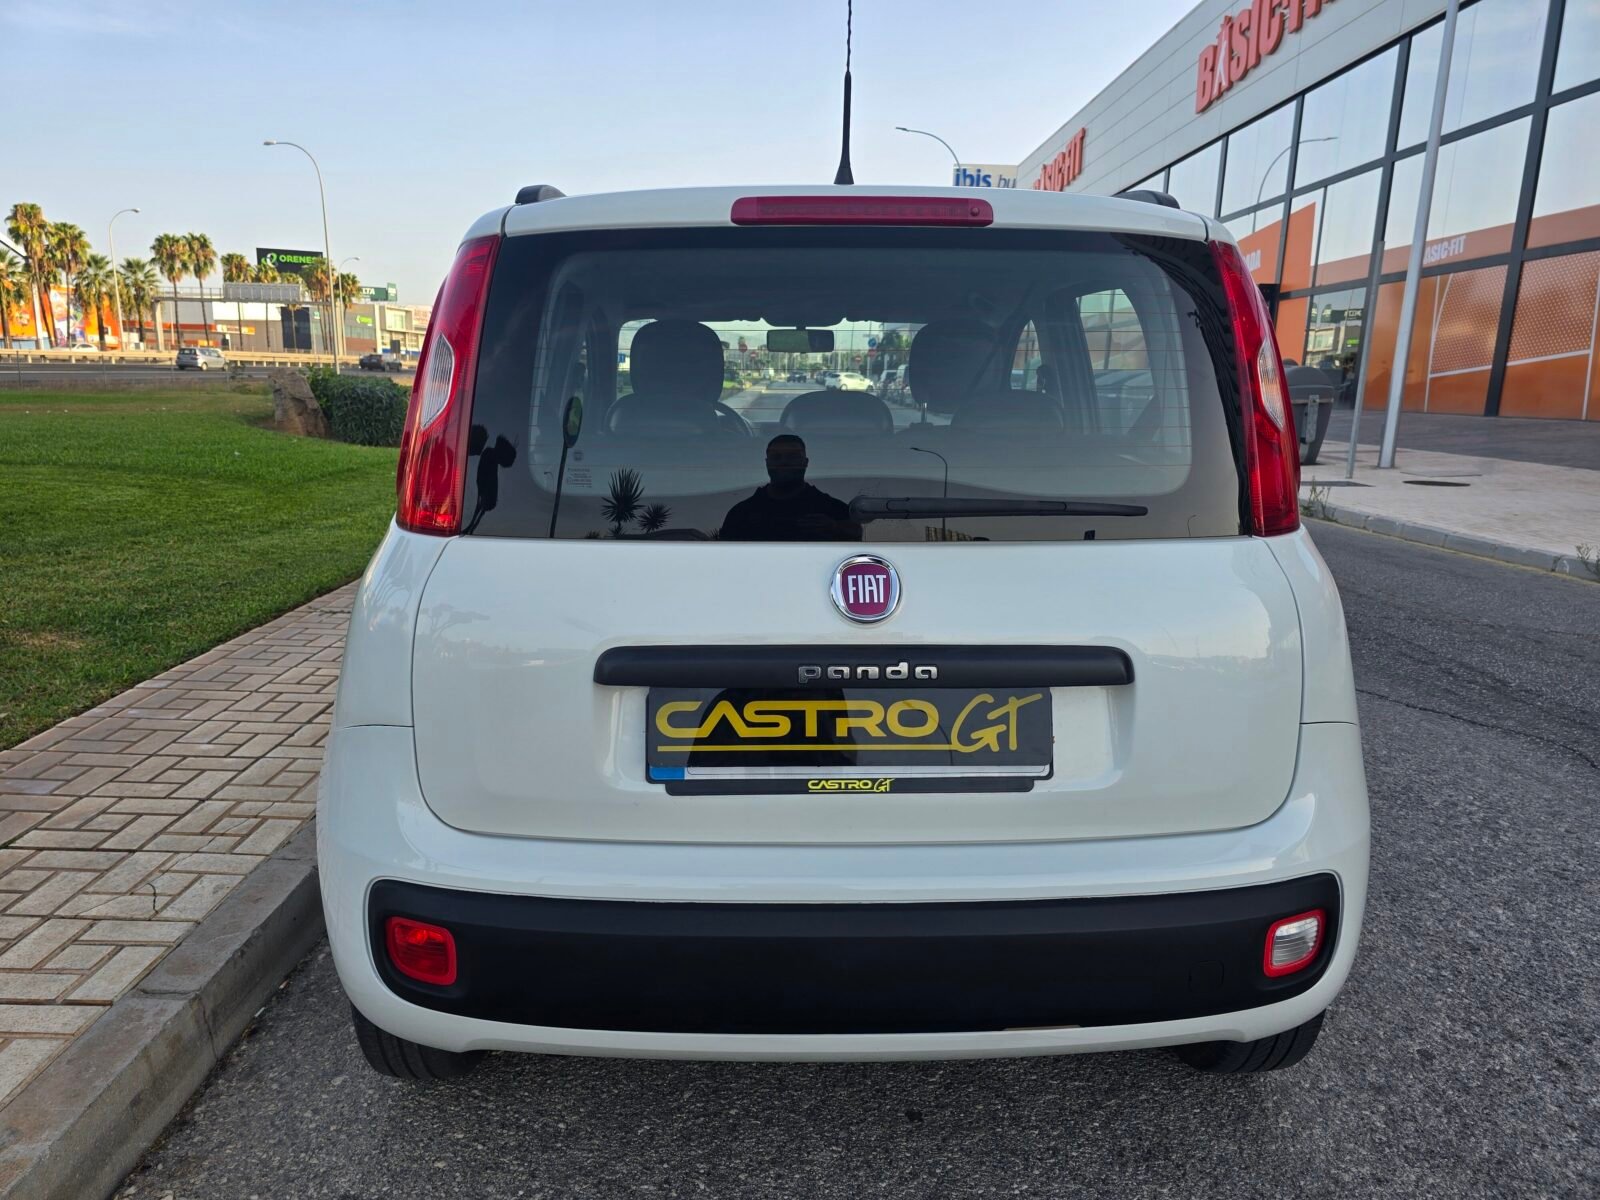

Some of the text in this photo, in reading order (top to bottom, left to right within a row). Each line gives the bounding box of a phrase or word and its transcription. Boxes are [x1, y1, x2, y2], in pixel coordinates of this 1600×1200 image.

[955, 167, 992, 187] ibis
[1423, 234, 1466, 265] ASIC-FIT
[847, 574, 887, 604] FIAT
[798, 661, 938, 684] panda
[655, 693, 1042, 753] CASTRO GT
[807, 778, 895, 792] CASTRO GT
